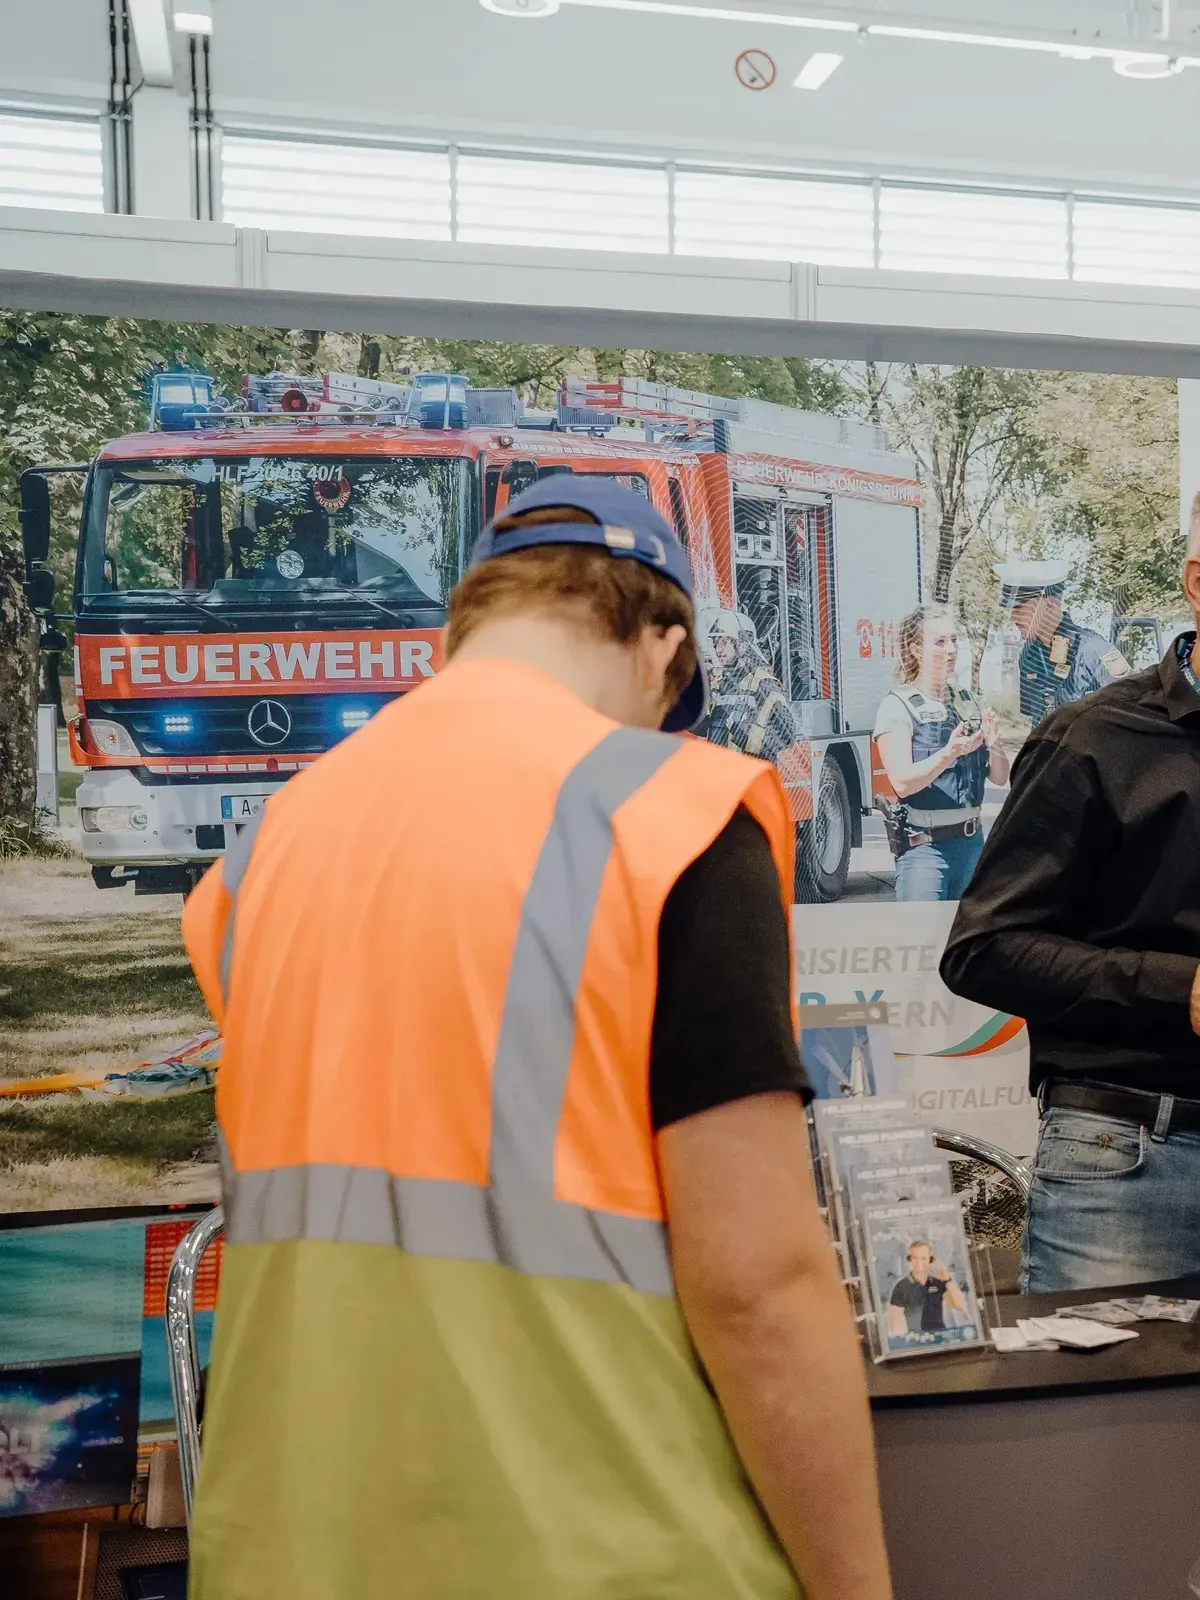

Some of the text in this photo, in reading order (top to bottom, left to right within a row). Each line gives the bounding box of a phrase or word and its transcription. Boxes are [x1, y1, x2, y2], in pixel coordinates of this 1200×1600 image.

[212, 465, 248, 482] HLF
[306, 465, 343, 482] 40/1
[313, 490, 351, 509] FEUERWEHR
[99, 640, 437, 686] FEUERWEHR
[909, 1084, 1032, 1111] IGITALFU
